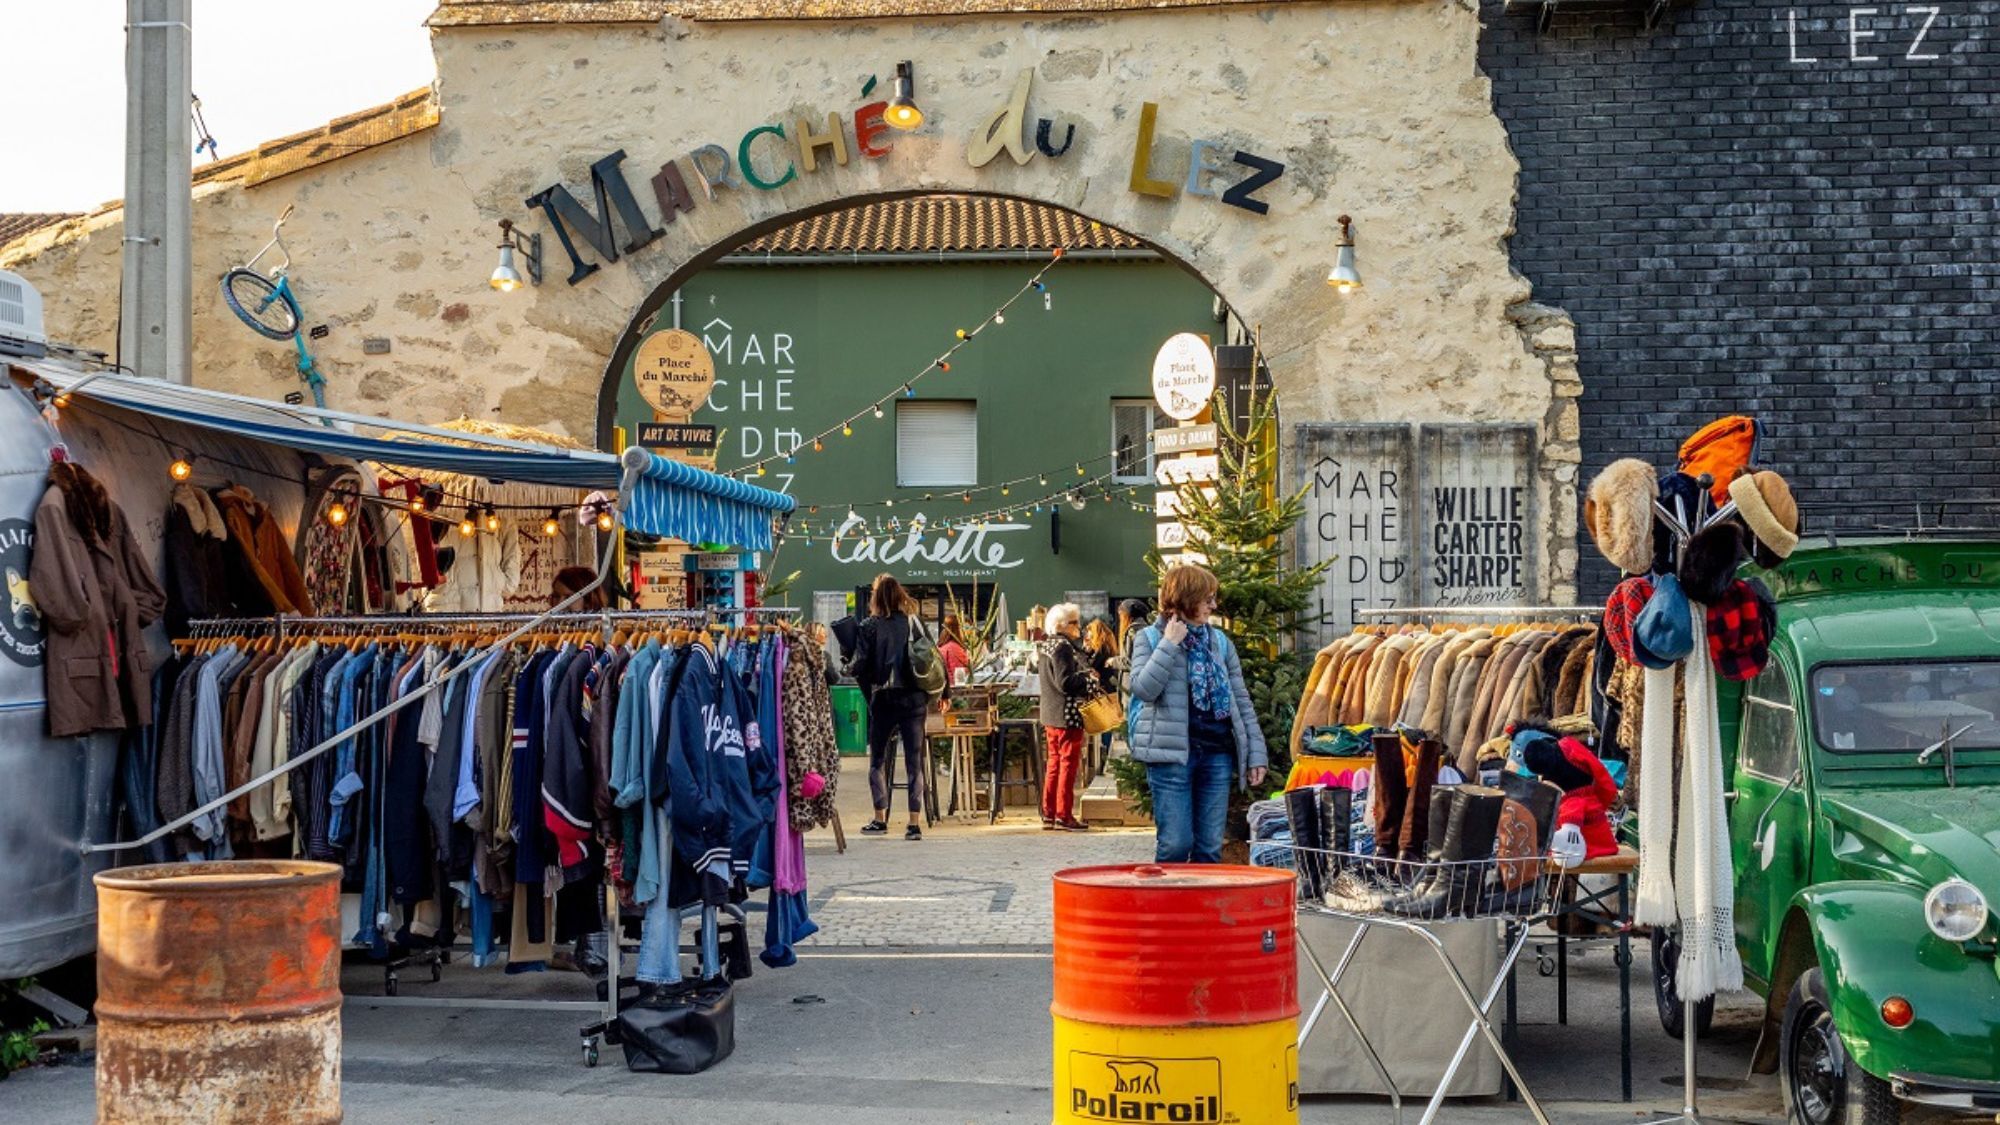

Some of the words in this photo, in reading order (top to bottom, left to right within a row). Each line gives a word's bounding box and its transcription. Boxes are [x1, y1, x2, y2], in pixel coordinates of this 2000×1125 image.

[1789, 6, 1940, 63] LEZ
[1129, 101, 1285, 216] LEZ
[659, 357, 691, 369] Place
[1171, 362, 1196, 373] Place
[643, 371, 658, 381] du
[1158, 378, 1171, 388] du
[643, 428, 663, 441] ART
[666, 428, 680, 441] DE
[682, 429, 713, 443] VIVRE
[1158, 433, 1178, 448] FOOD
[1188, 429, 1215, 445] DRINK
[1434, 486, 1523, 521] WILLIE
[831, 512, 1032, 568] Cachette
[1434, 523, 1523, 555] CARTER
[943, 569, 998, 577] RESTAURANT
[1434, 555, 1523, 588] SHARPE
[1942, 563, 1983, 579] DU
[1320, 598, 1397, 625] LEZ
[1072, 1087, 1218, 1123] Polaroil
